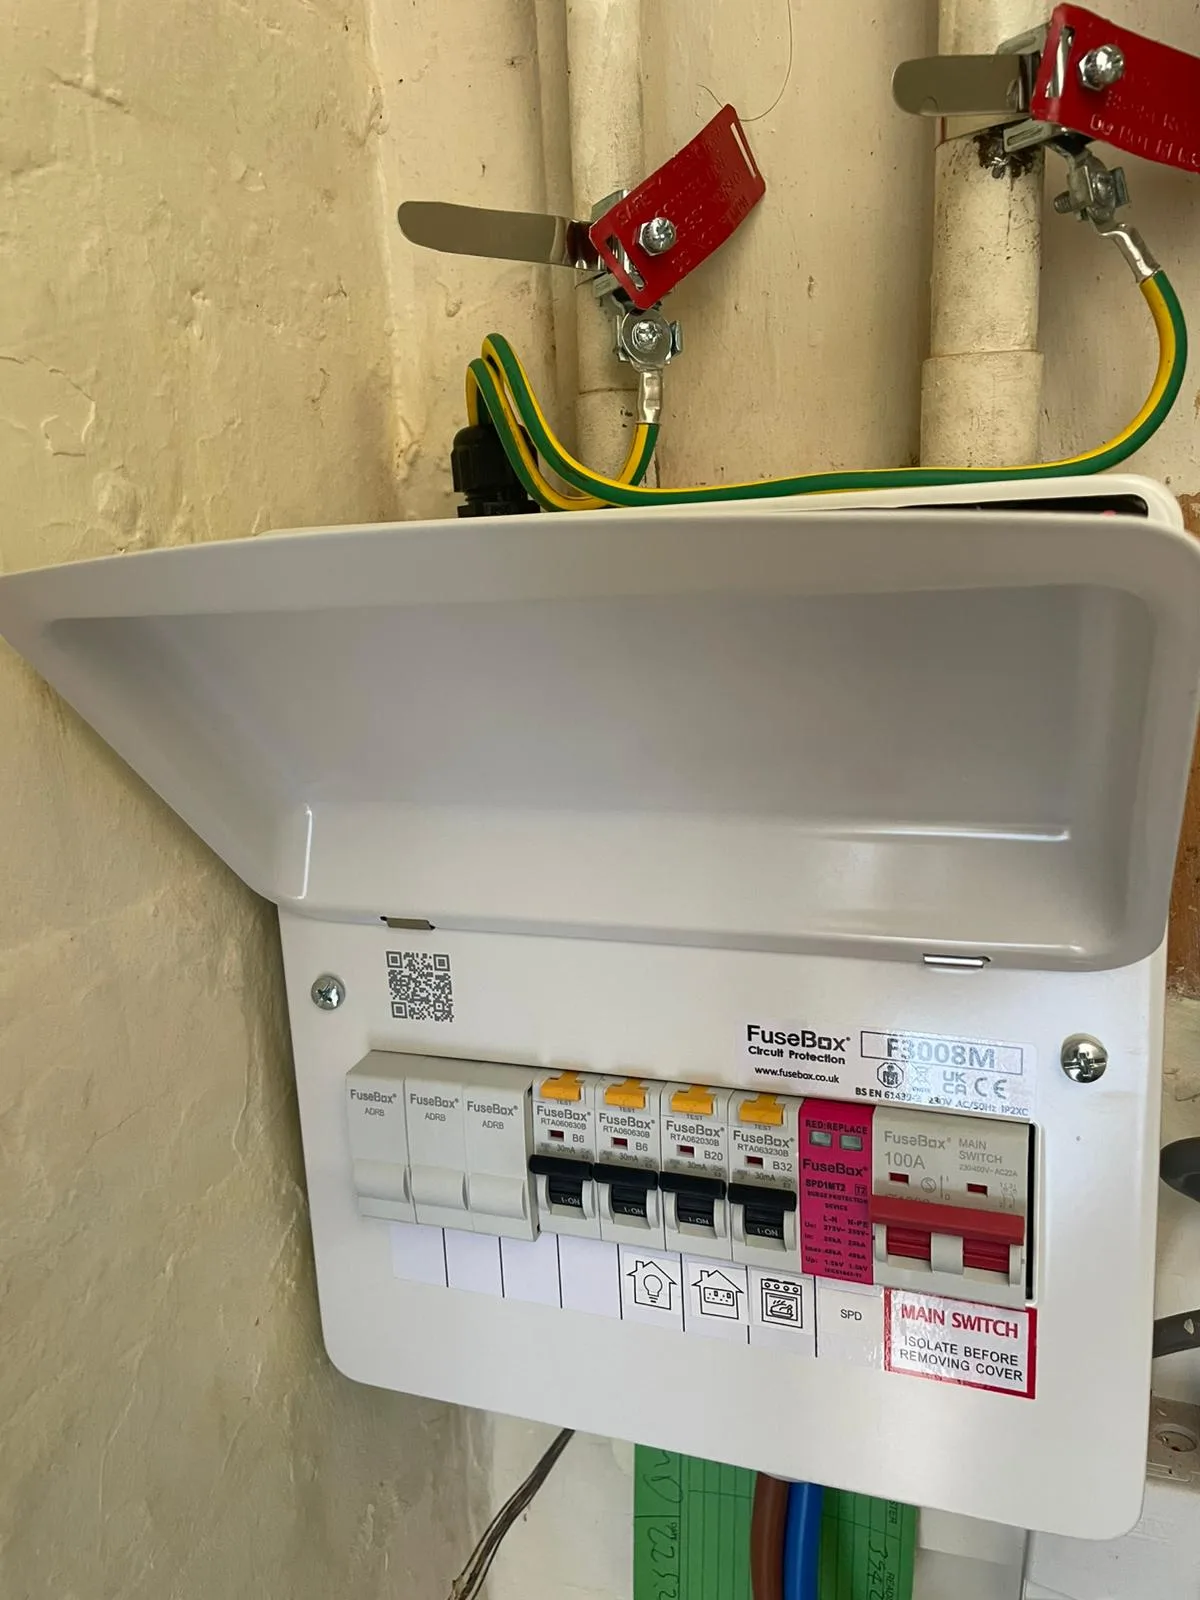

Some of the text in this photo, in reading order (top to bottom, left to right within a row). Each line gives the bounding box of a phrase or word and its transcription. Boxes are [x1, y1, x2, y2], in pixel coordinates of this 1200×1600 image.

[748, 1046, 846, 1065] Circuit Protection
[887, 1038, 995, 1068] F3008M
[755, 1067, 839, 1083] www.fusebox.co.uk
[855, 1087, 867, 1096] BS
[869, 1089, 882, 1098] EN
[974, 1077, 1008, 1100] CE
[364, 1107, 385, 1116] ADRB
[424, 1112, 446, 1121] ADRB
[482, 1120, 504, 1130] ADRB
[572, 1134, 585, 1143] B6
[958, 1138, 987, 1150] MAIN
[557, 1144, 576, 1154] 30mA
[635, 1142, 649, 1151] B6
[619, 1152, 639, 1161] 30mA
[704, 1150, 723, 1161] B20
[885, 1151, 925, 1170] 100A
[959, 1150, 1003, 1164] SWITCH
[772, 1161, 793, 1172] B32
[755, 1172, 775, 1181] 30mA
[806, 1179, 846, 1191] SPD1MT2
[840, 1308, 863, 1321] SPD
[901, 1303, 1019, 1339] MAIN SWITCH
[904, 1335, 1019, 1366] ISOLATE BEFORE
[900, 1349, 1023, 1382] REMOVING COVER
